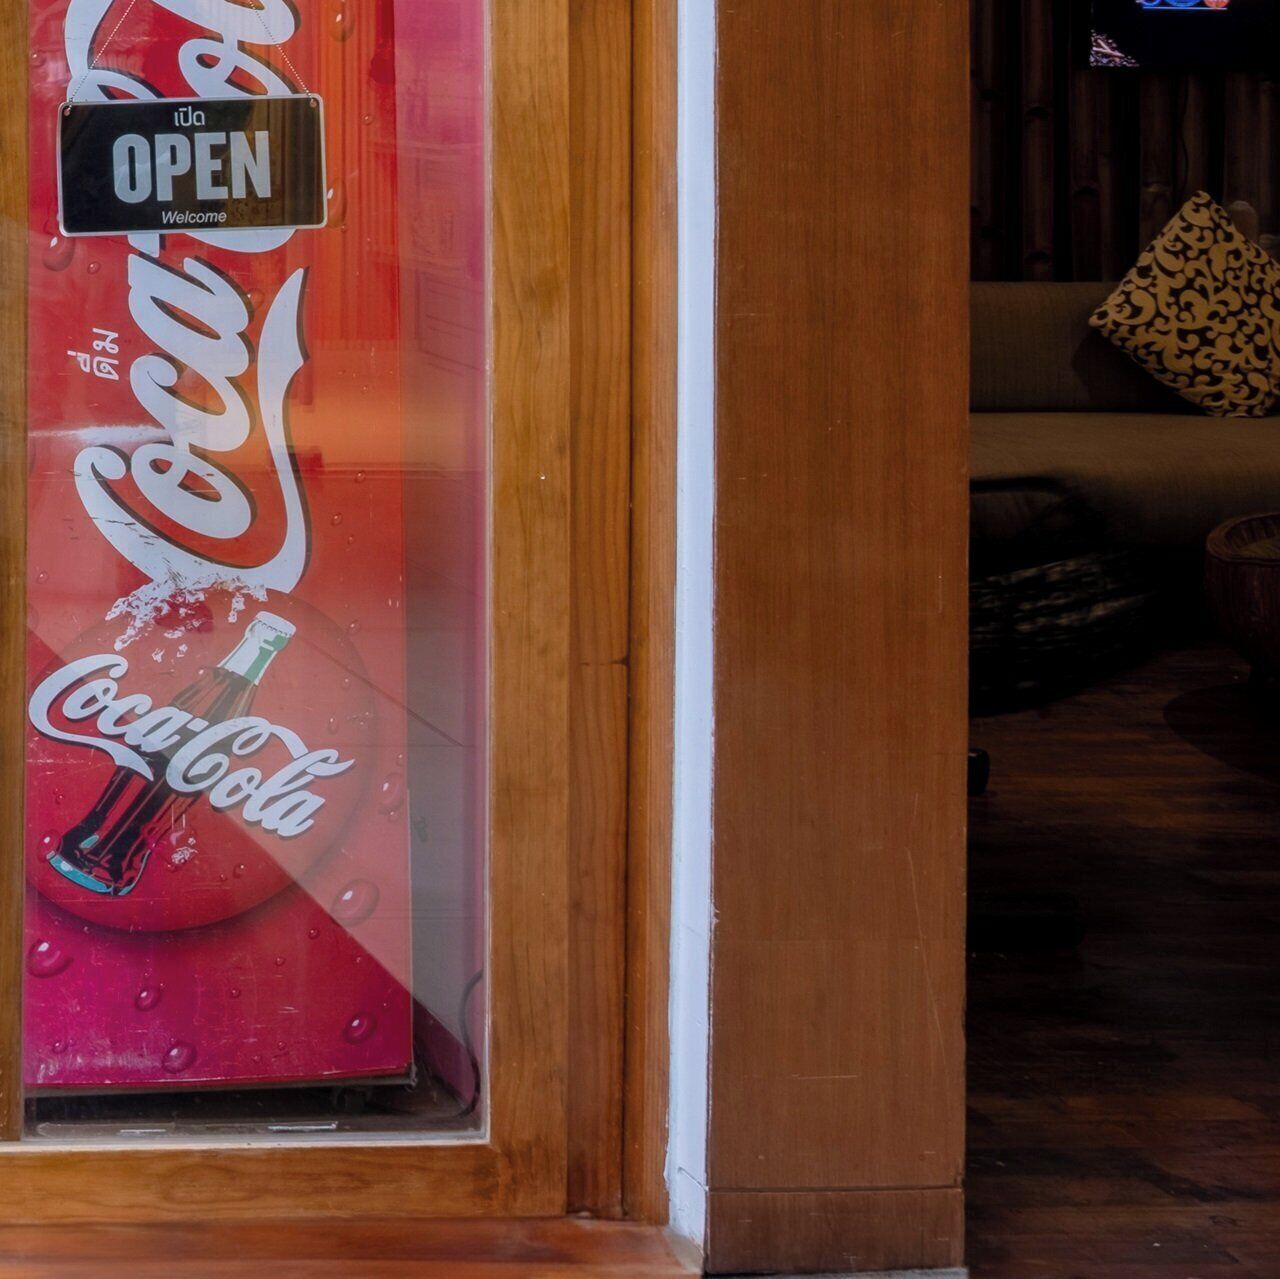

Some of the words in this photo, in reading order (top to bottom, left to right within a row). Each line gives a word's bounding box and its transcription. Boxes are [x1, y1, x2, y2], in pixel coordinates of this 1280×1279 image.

[173, 106, 206, 127] เปิด
[112, 131, 272, 204] OPEN
[161, 211, 227, 225] Welcome
[67, 327, 119, 381] ดื่ม
[28, 654, 355, 837] Coca-Cola
